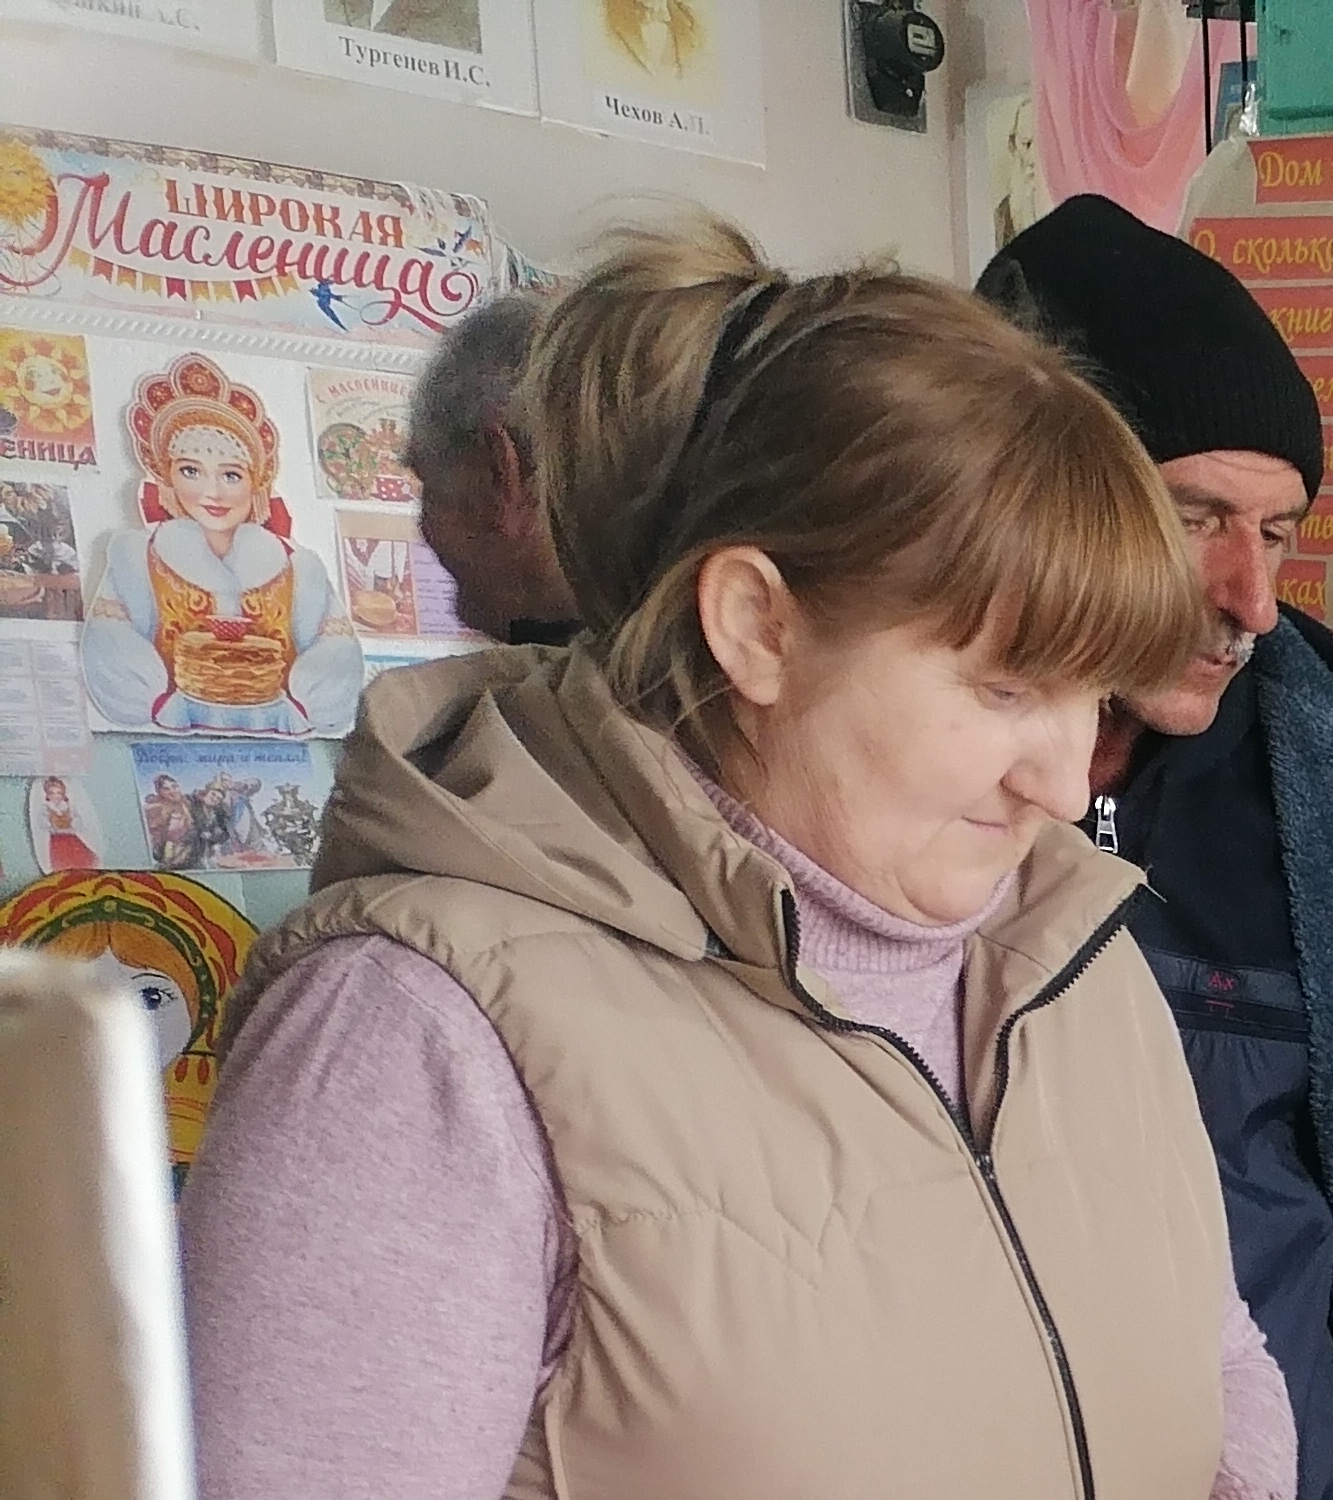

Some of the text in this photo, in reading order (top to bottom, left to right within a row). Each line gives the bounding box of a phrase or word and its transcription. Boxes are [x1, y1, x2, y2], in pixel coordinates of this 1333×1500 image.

[338, 36, 491, 87] Тургенев И.С.
[605, 95, 663, 125] Чехов
[1258, 151, 1323, 188] Дом
[164, 178, 405, 248] ШИРОКАЯ
[56, 173, 480, 334] Масленица
